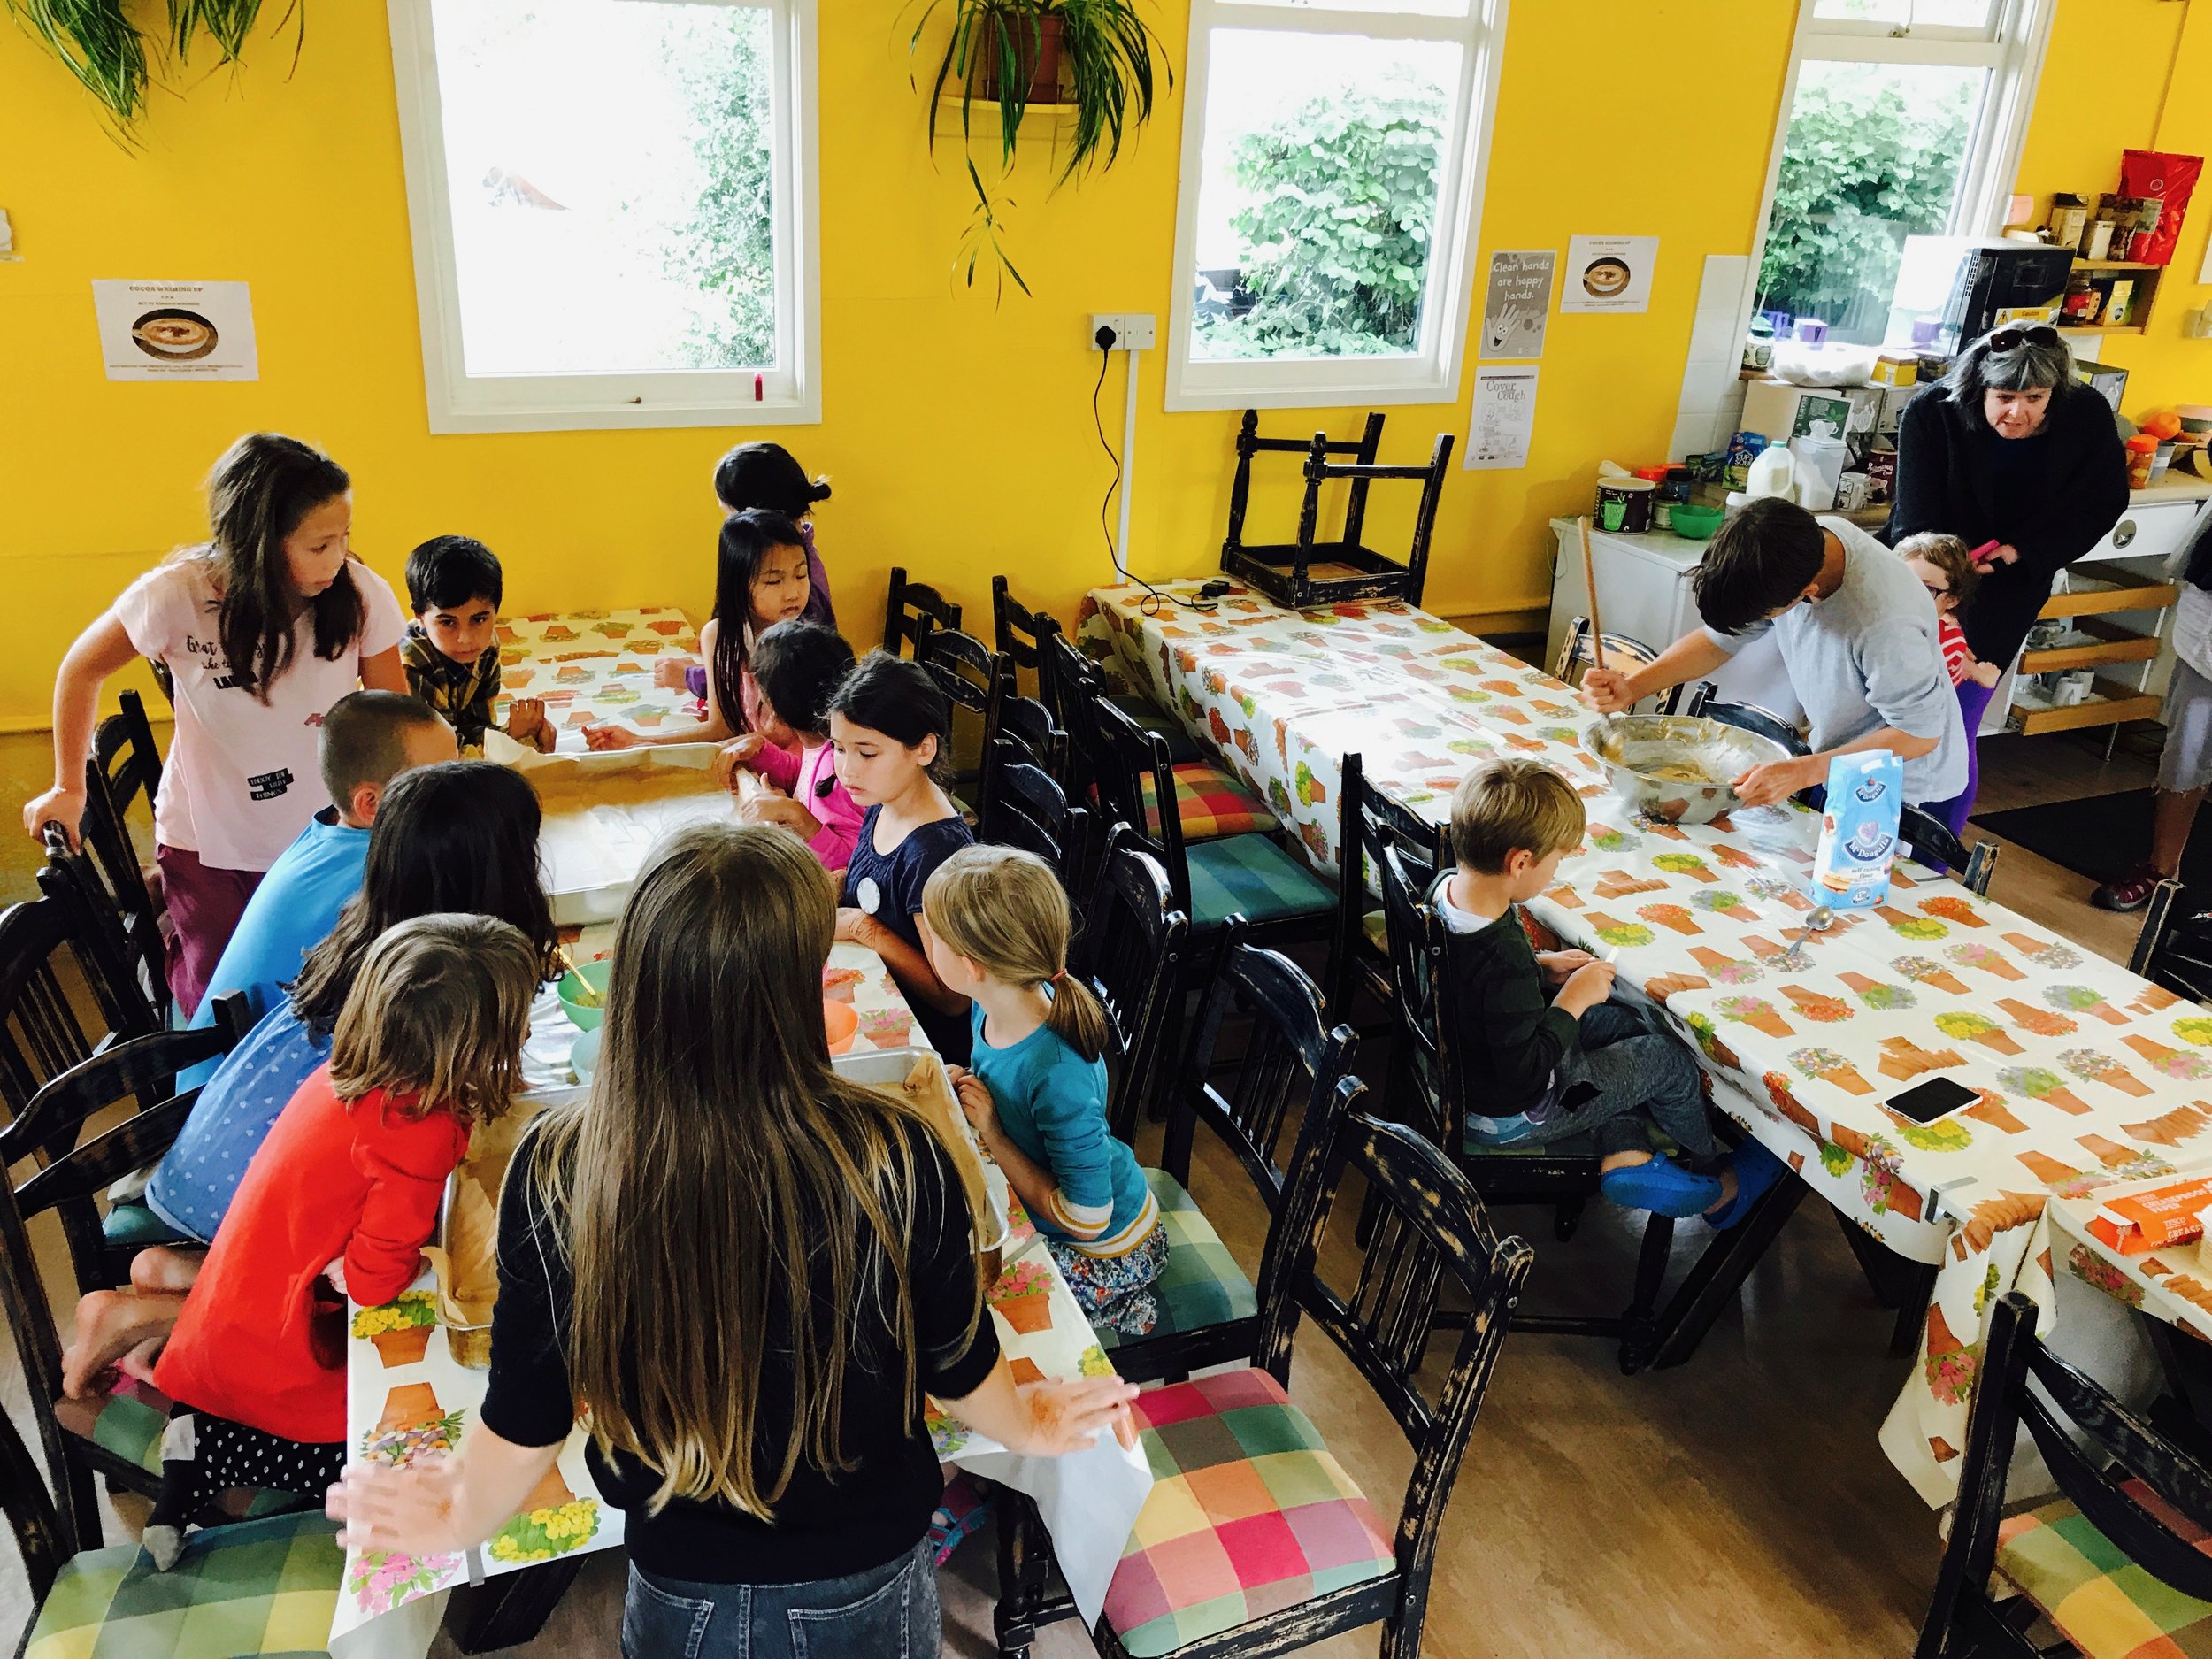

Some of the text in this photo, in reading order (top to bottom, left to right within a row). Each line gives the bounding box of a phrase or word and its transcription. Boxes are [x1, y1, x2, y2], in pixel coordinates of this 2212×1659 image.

[1493, 259, 1550, 273] Clean hands
[1515, 275, 1545, 288] happy
[1504, 289, 1534, 302] hands.
[1486, 380, 1517, 393] Cover
[1496, 389, 1526, 403] Cough
[2162, 1217, 2186, 1228] TESCO
[2167, 1223, 2205, 1240] GREASE
